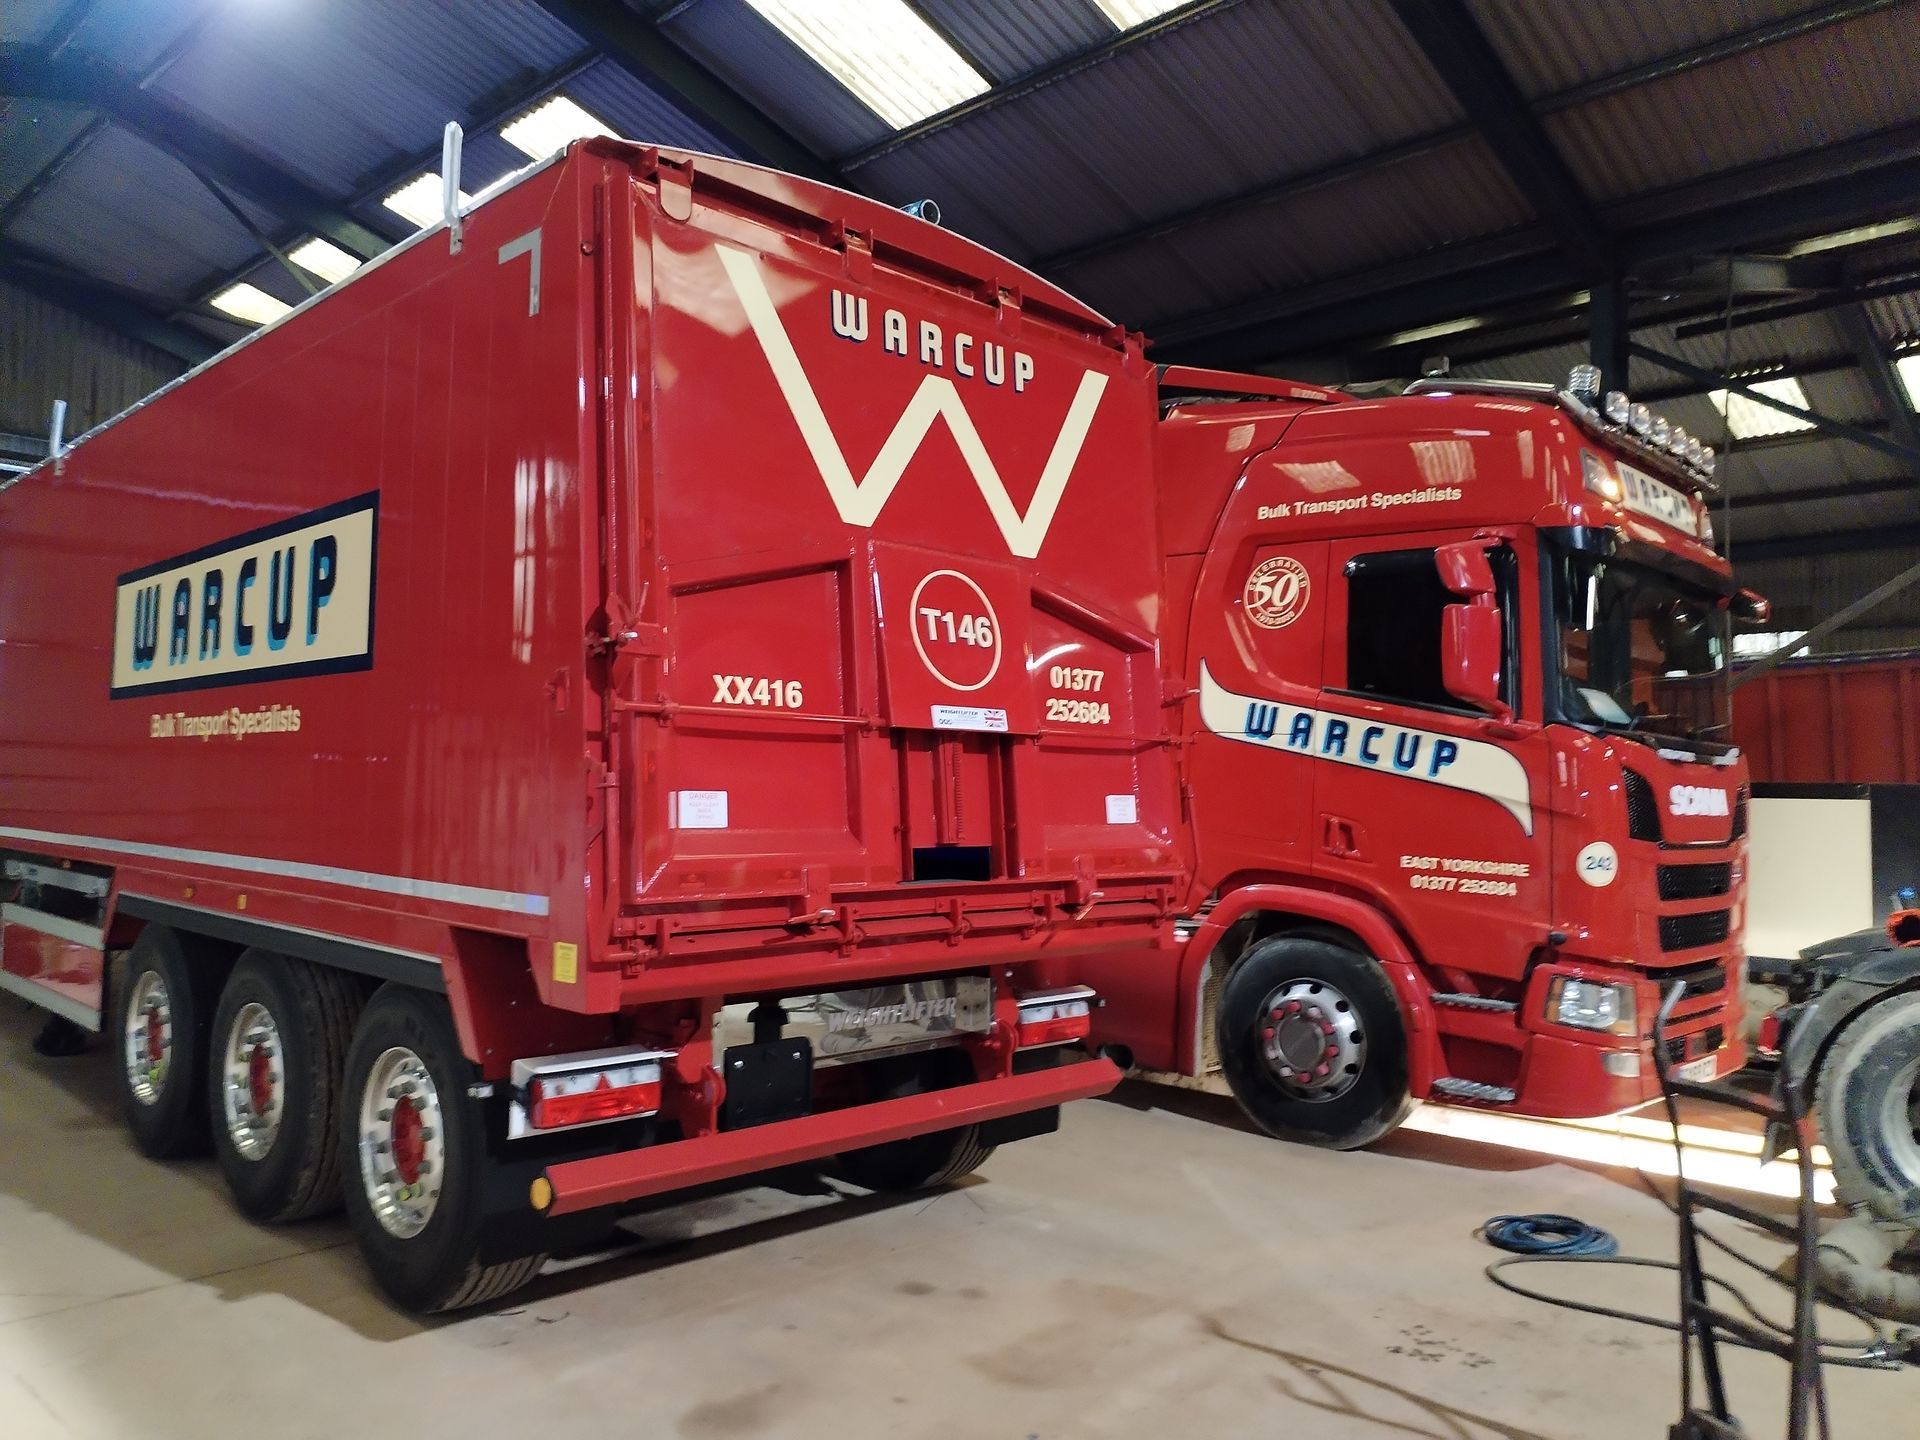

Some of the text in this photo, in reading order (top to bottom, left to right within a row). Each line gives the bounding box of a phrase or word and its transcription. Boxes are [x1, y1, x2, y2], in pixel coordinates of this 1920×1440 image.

[831, 289, 1034, 393] WARCUP
[715, 243, 1109, 559] W
[1257, 486, 1462, 520] Bulk Transport Specialists
[132, 534, 337, 672] WARCUP
[1245, 573, 1299, 608] 50
[919, 607, 993, 648] T146
[712, 674, 803, 709] XX416
[1050, 666, 1104, 692] 01377
[150, 704, 300, 742] Bulk Transport Specialists
[1046, 698, 1110, 725] 252684
[1245, 702, 1458, 777] WARCUP
[1400, 855, 1530, 877] EAST YORKSHIRE
[1585, 855, 1613, 870] 242
[1410, 874, 1517, 896] 01377 252684
[829, 997, 957, 1032] WEIGHTLIFTER
